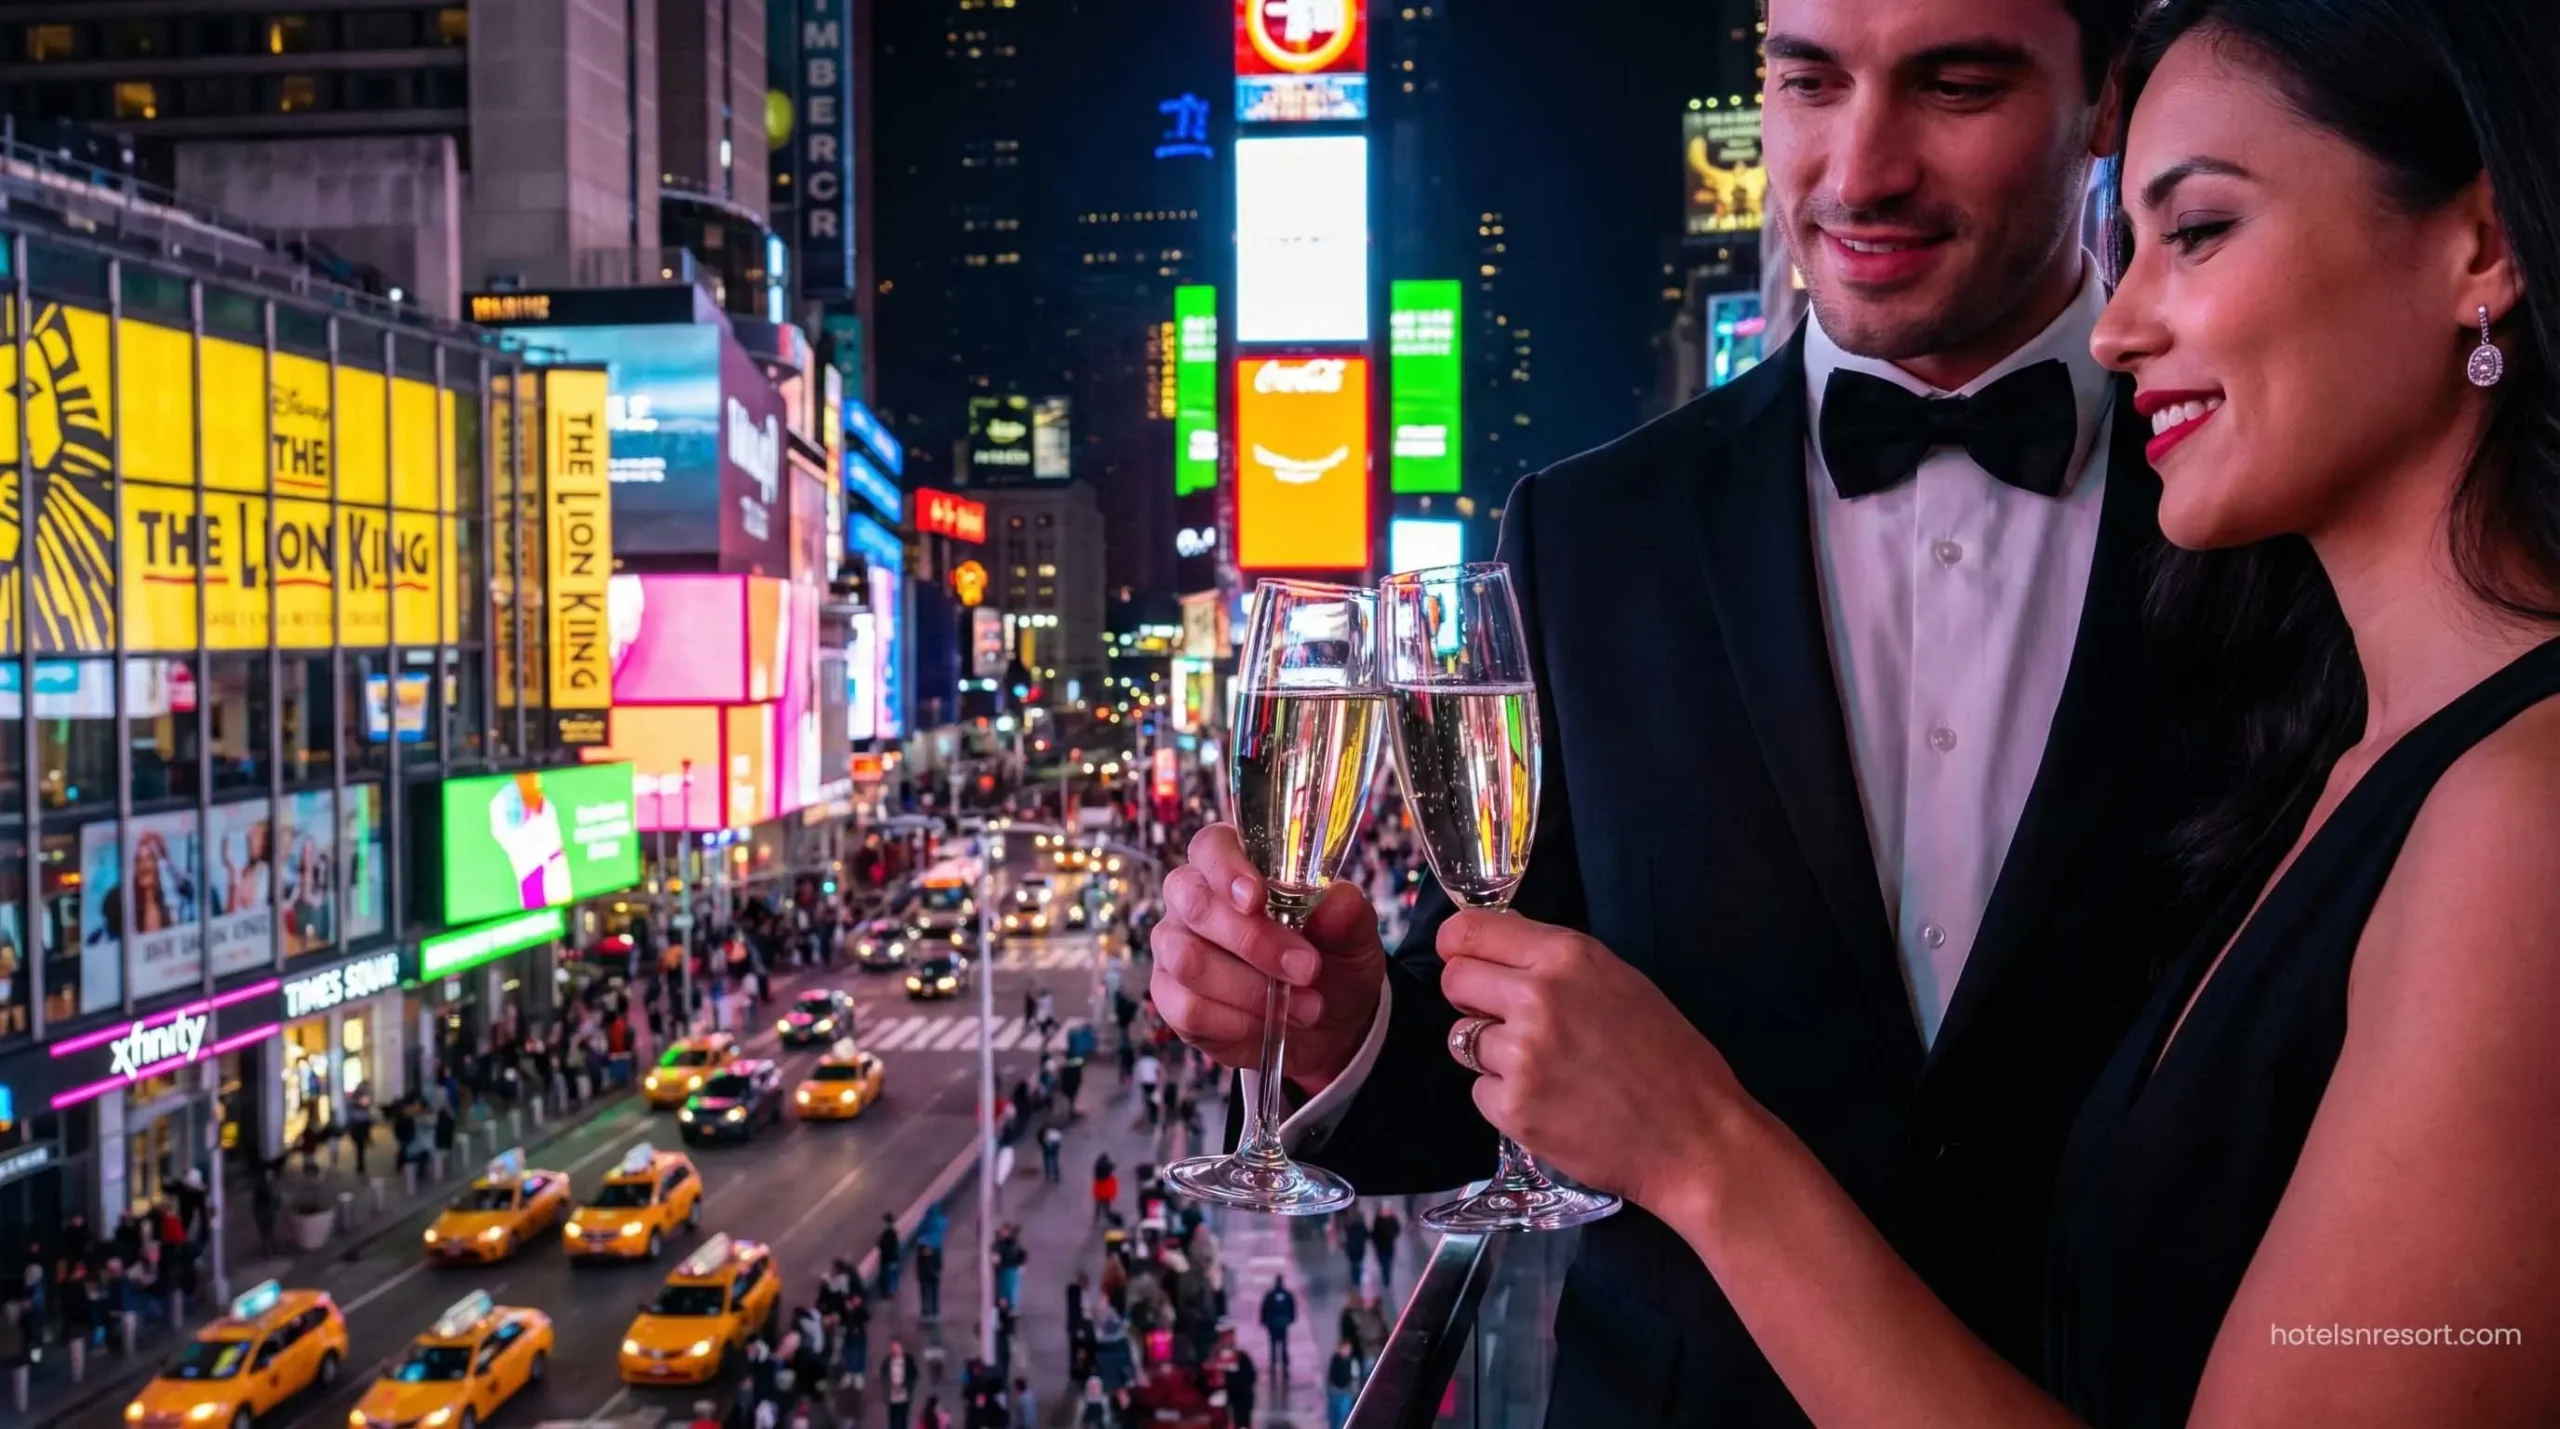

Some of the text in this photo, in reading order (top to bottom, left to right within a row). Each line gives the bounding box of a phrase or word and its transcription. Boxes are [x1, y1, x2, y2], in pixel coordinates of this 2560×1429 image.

[273, 434, 326, 476] THE
[568, 412, 593, 477] THE
[138, 510, 222, 566] THE
[239, 501, 335, 588] LION
[557, 492, 601, 576] LION
[109, 1009, 208, 1081] xfinity
